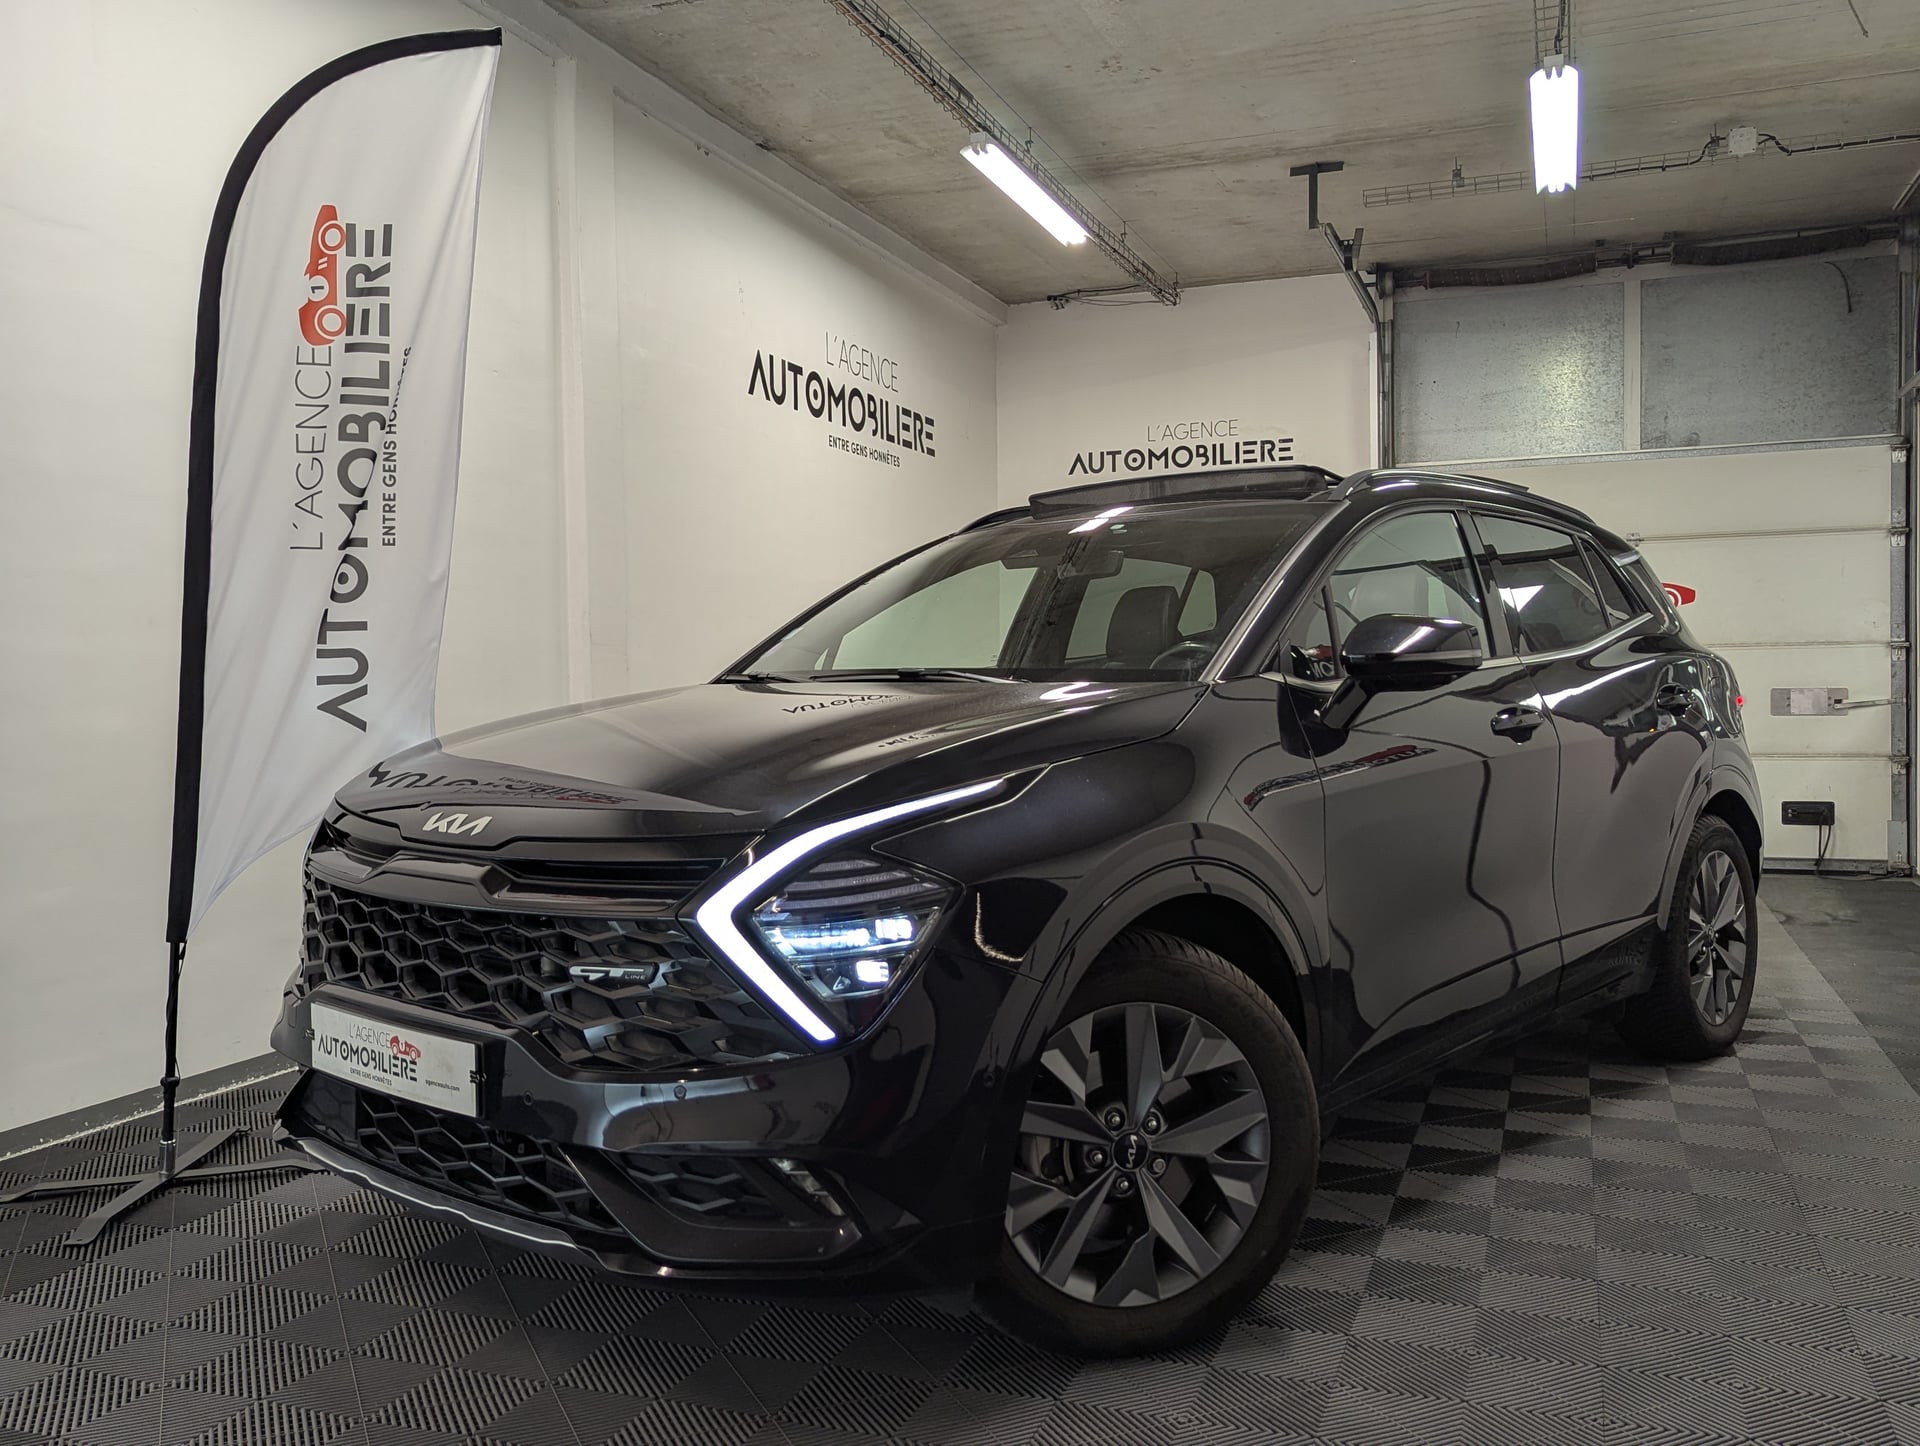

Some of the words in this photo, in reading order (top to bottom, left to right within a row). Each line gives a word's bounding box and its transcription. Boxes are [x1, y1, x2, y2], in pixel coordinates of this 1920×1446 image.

[825, 331, 899, 393] L'AGENCE
[747, 349, 936, 457] AUTOMOBILIERE
[289, 345, 332, 550] L'AGENCE
[828, 434, 850, 453] ENTRE
[850, 442, 868, 458] GENS
[868, 449, 901, 468] HONNÊTES
[1147, 418, 1239, 442] L'AGENCE
[316, 222, 394, 734] AUTOMOBILIERE
[381, 439, 397, 488] GENS
[1068, 437, 1294, 476] AUTOMOBILIERE
[381, 492, 397, 547] ENTRE
[318, 1033, 418, 1082] AUTOMOBILIERE
[349, 1023, 391, 1049] L'AGENCE
